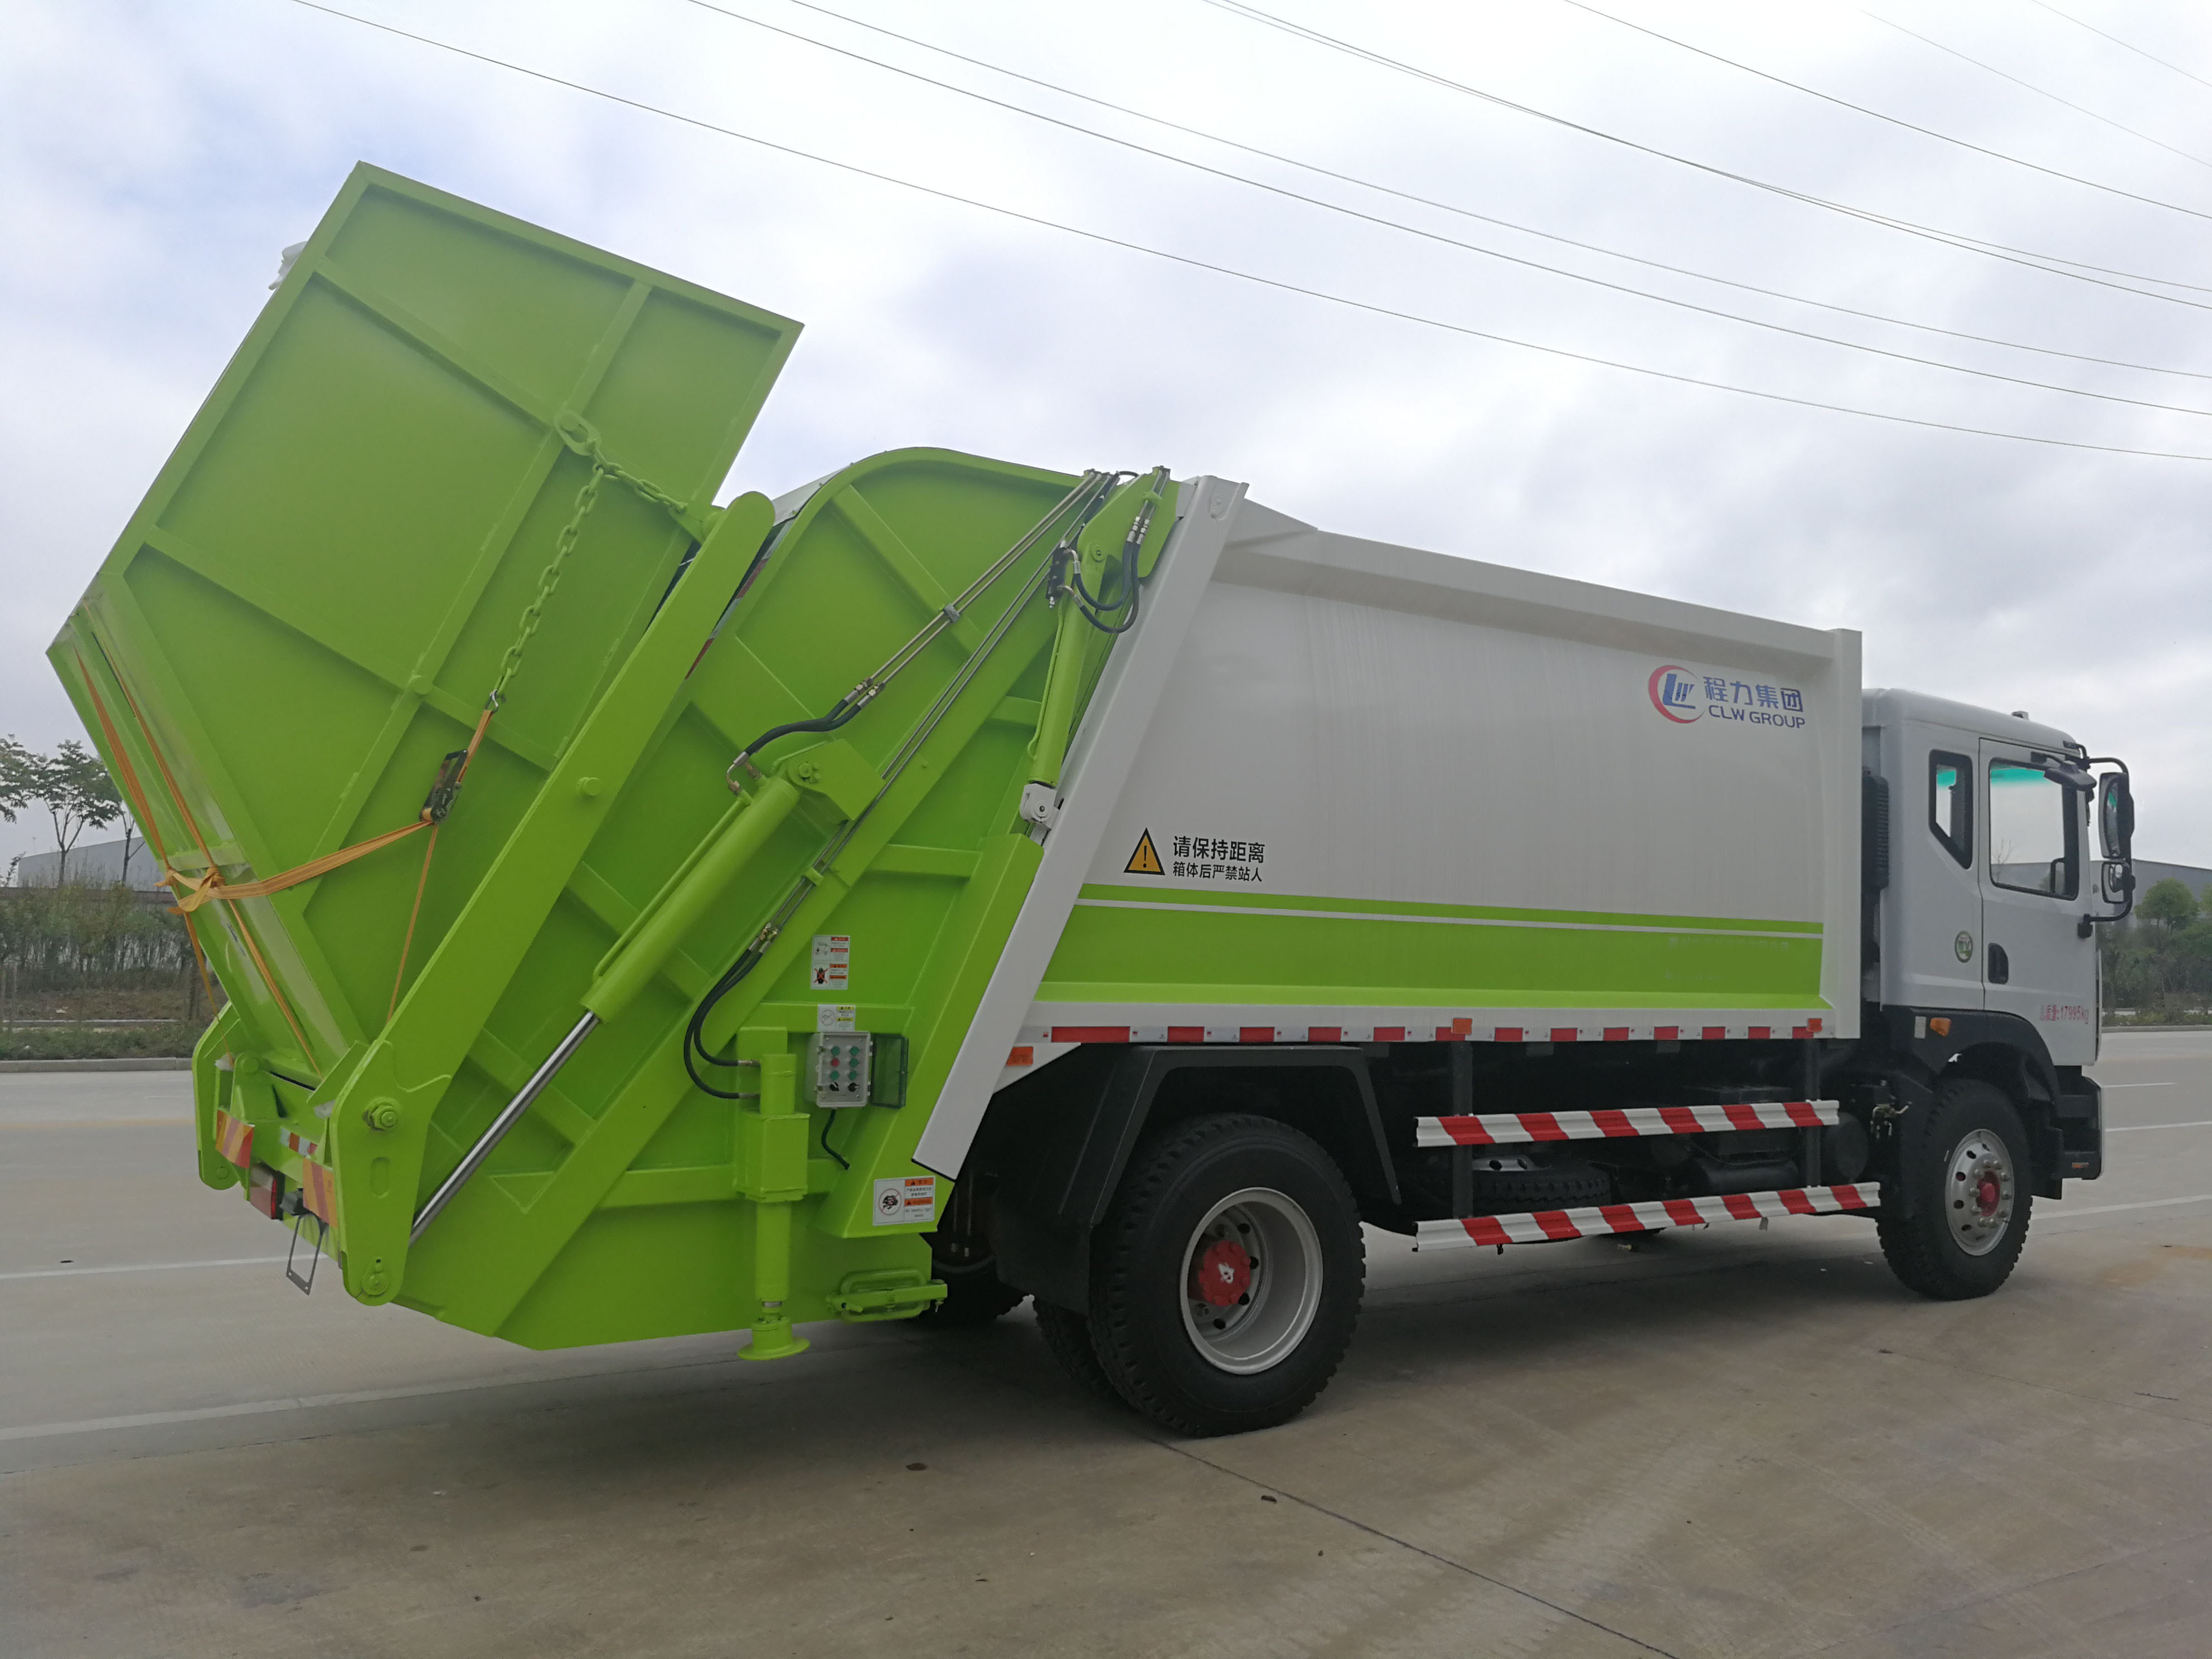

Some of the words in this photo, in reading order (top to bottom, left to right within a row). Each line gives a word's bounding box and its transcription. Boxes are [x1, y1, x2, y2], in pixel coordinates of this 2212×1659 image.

[1702, 676, 1803, 712] 程力集团
[1708, 705, 1745, 721] CLW
[1749, 711, 1805, 729] GROUP
[1173, 836, 1265, 864] 请保持距离
[1173, 861, 1262, 882] 箱体后严禁站人
